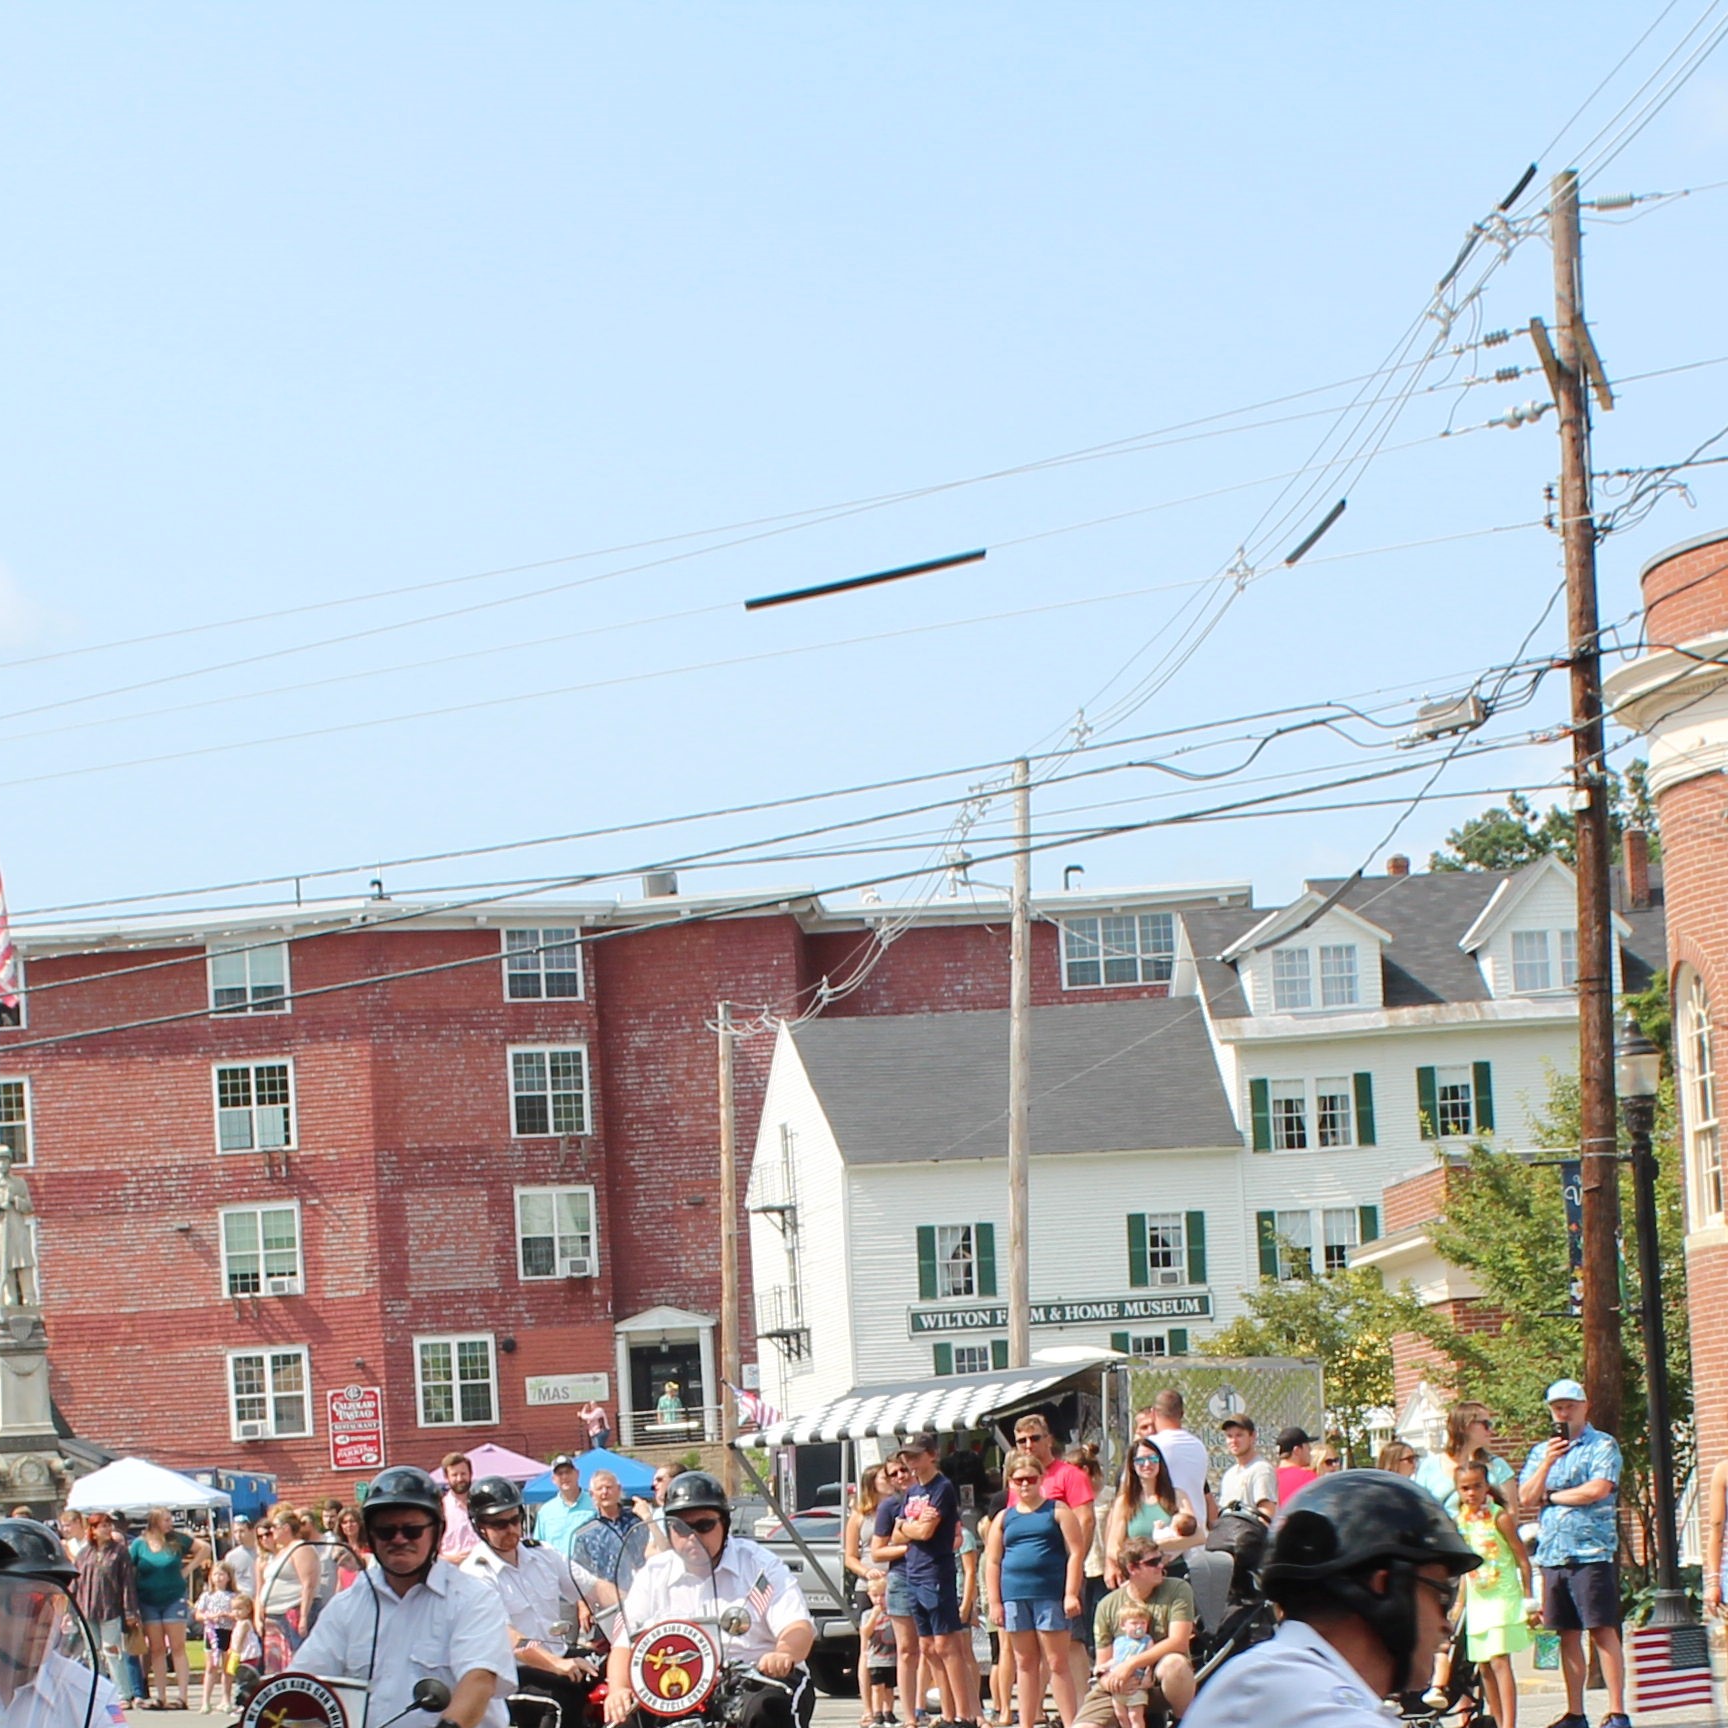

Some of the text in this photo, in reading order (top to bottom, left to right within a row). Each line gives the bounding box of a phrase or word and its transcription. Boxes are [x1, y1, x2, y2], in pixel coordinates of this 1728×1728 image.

[920, 1297, 1202, 1330] WILTON FM & HOME MUSEUM
[290, 1679, 313, 1692] KIDS
[313, 1686, 330, 1705] CAN
